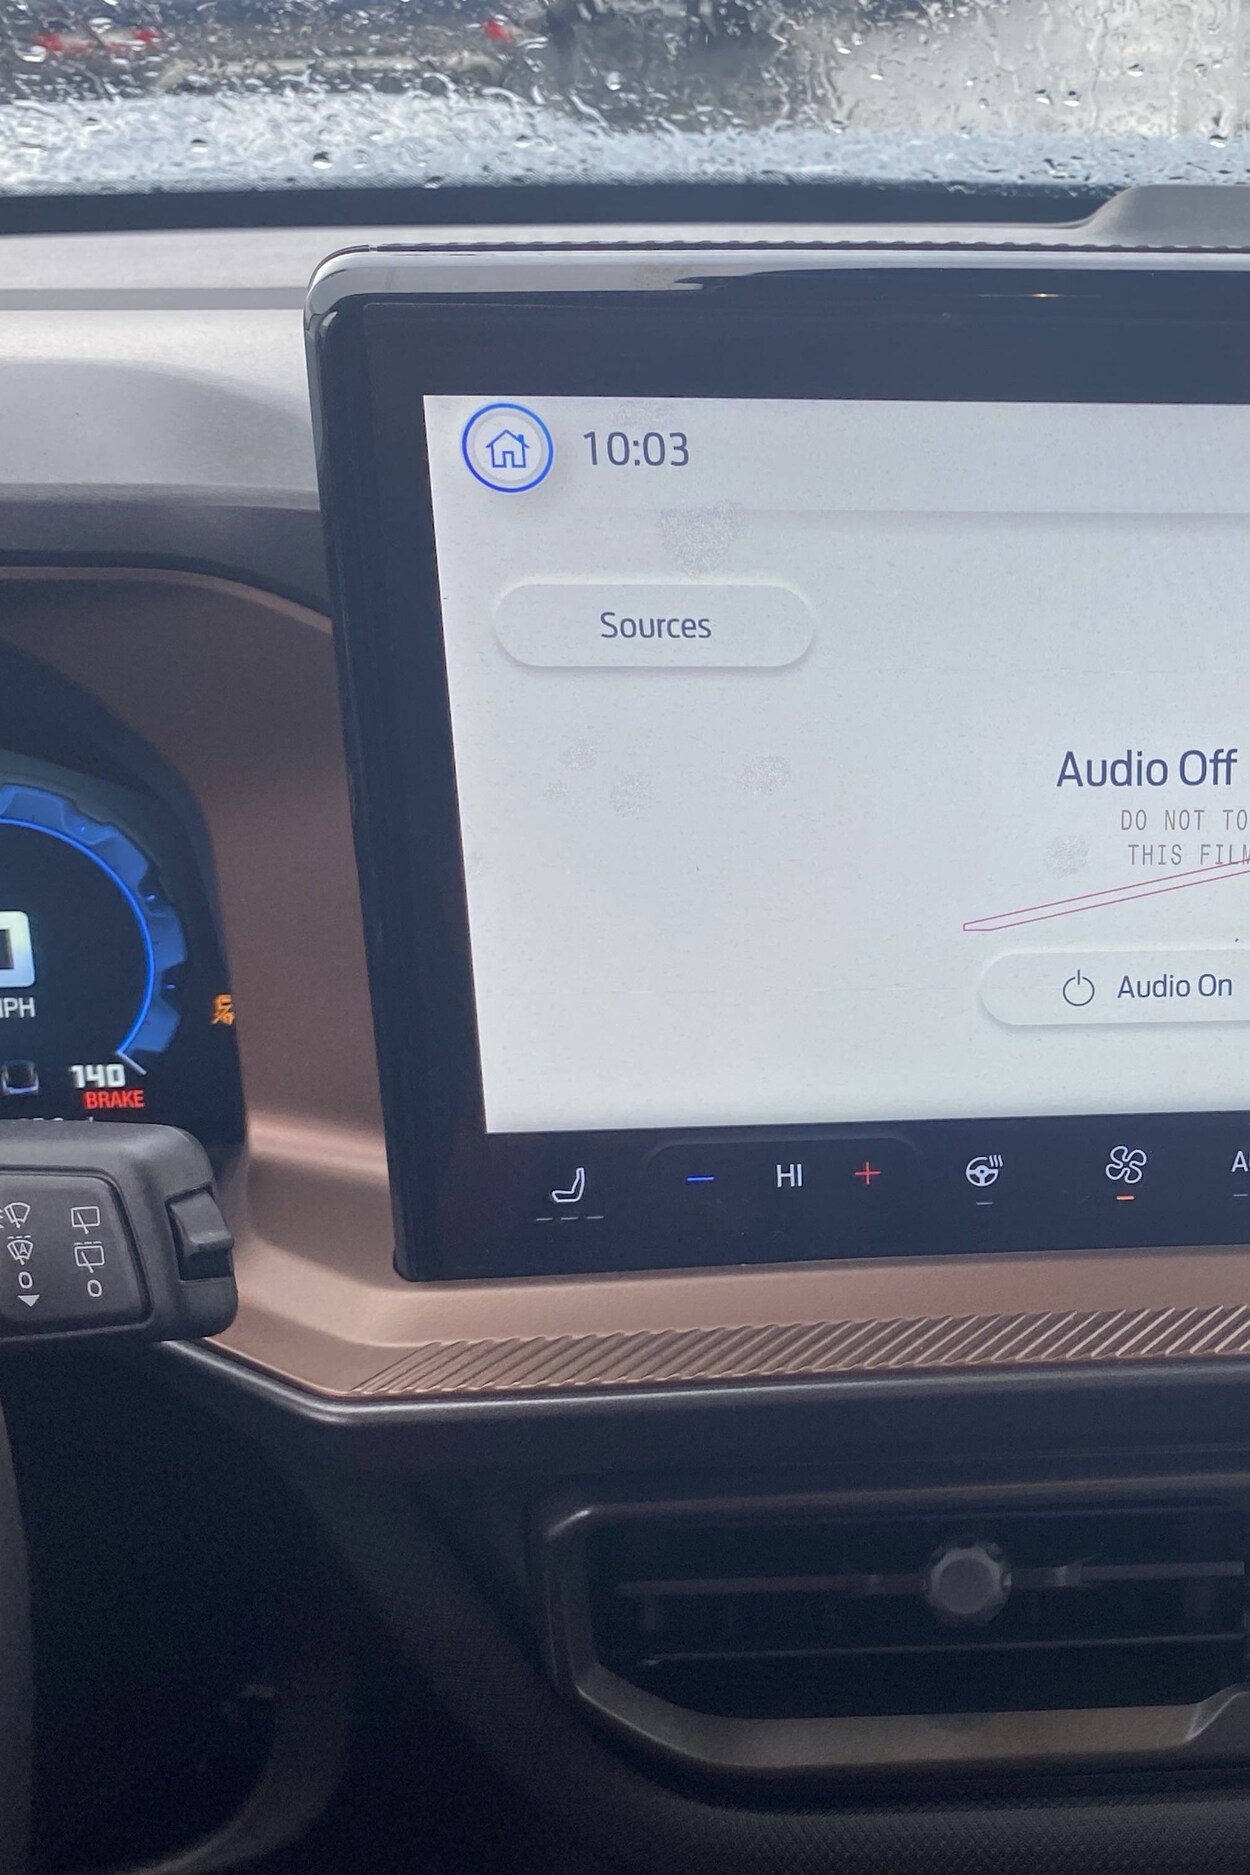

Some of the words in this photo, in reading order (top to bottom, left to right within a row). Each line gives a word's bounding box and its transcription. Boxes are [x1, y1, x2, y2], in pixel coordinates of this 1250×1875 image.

[583, 431, 690, 467] 10:03
[600, 611, 712, 639] Sources
[1056, 749, 1169, 788] Audio
[1179, 748, 1239, 787] Off
[1120, 808, 1147, 831] DO
[1164, 808, 1205, 831] NOT
[1127, 843, 1183, 866] THIS
[1117, 973, 1191, 999] Audio
[1198, 973, 1233, 997] On
[70, 1063, 125, 1089] 140
[83, 1090, 145, 1109] BRAKE
[776, 1163, 803, 1188] HI
